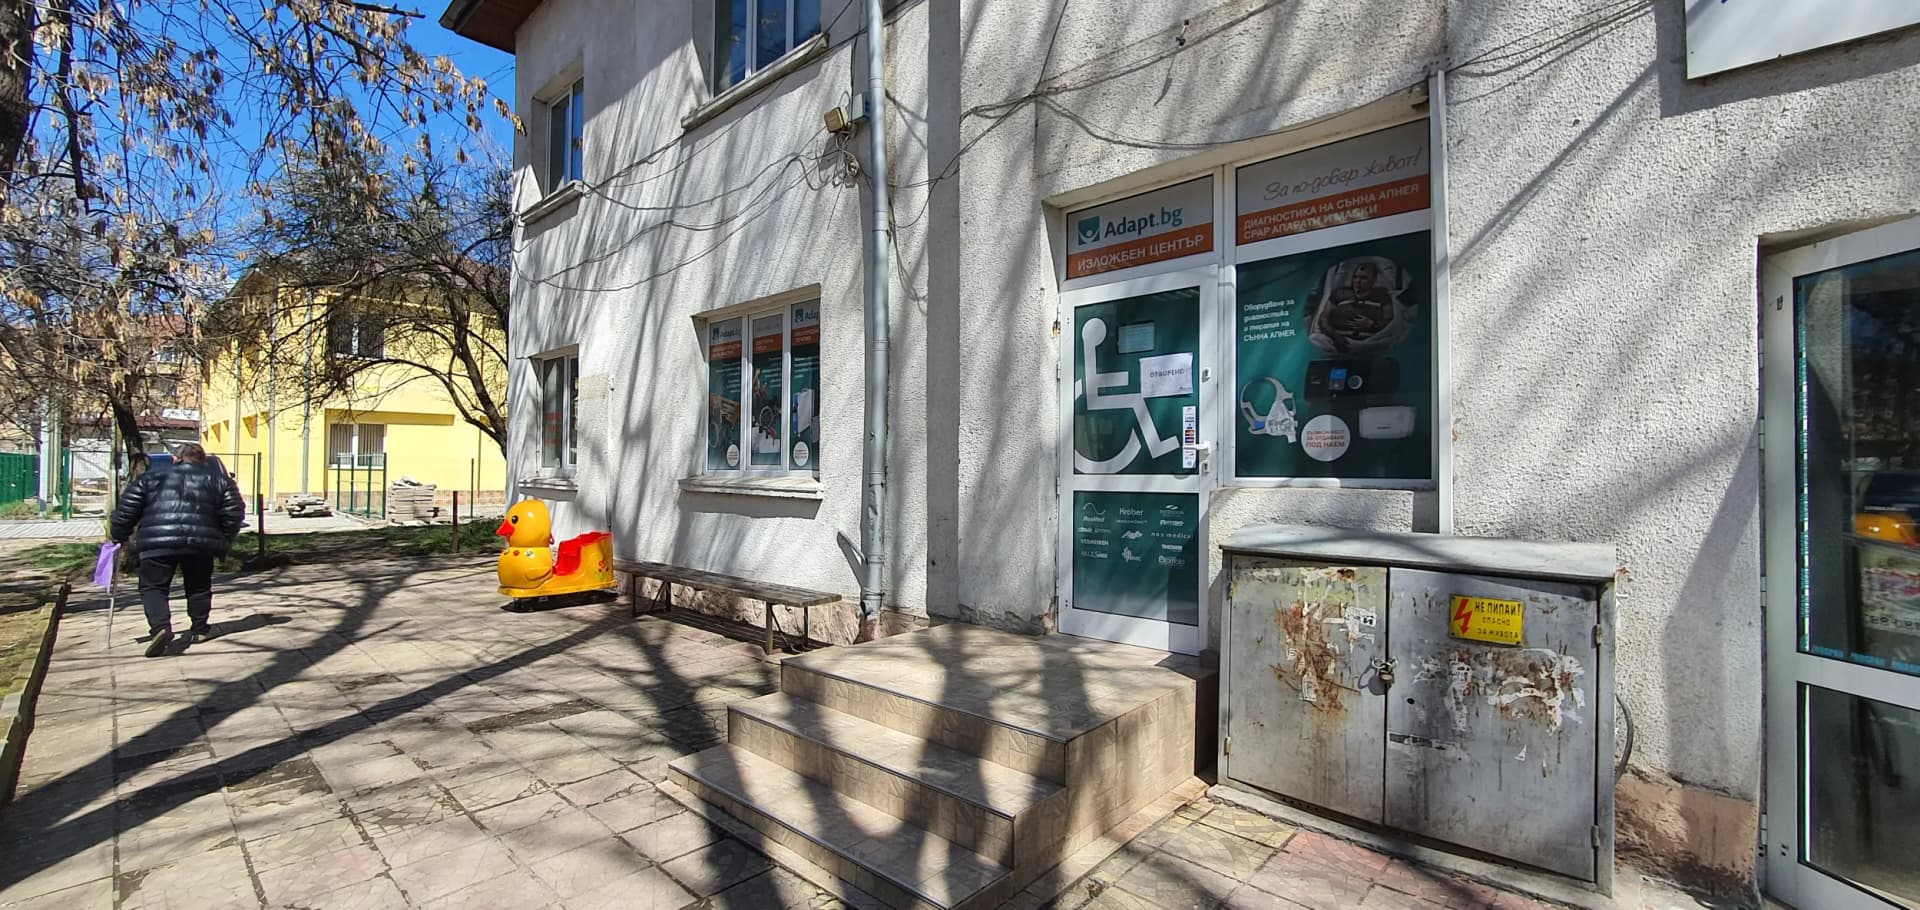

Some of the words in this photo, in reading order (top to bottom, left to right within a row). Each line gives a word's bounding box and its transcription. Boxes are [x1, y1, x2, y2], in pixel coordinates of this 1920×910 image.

[1243, 205, 1318, 231] ДИАГНОСТИКА
[1319, 202, 1335, 214] НА
[1336, 194, 1377, 210] СЪННА
[1379, 183, 1420, 202] АПНЕЯ
[1104, 206, 1183, 239] Adapt.bg
[1077, 248, 1146, 271] ИЗЛОЖБЕН
[1149, 234, 1205, 257] ЦЕНТЪР
[1243, 332, 1268, 342] СЪННА
[1475, 602, 1485, 612] НЕ
[1488, 602, 1520, 616] ПИПАЙ!
[1482, 616, 1511, 626] ОПАСНО
